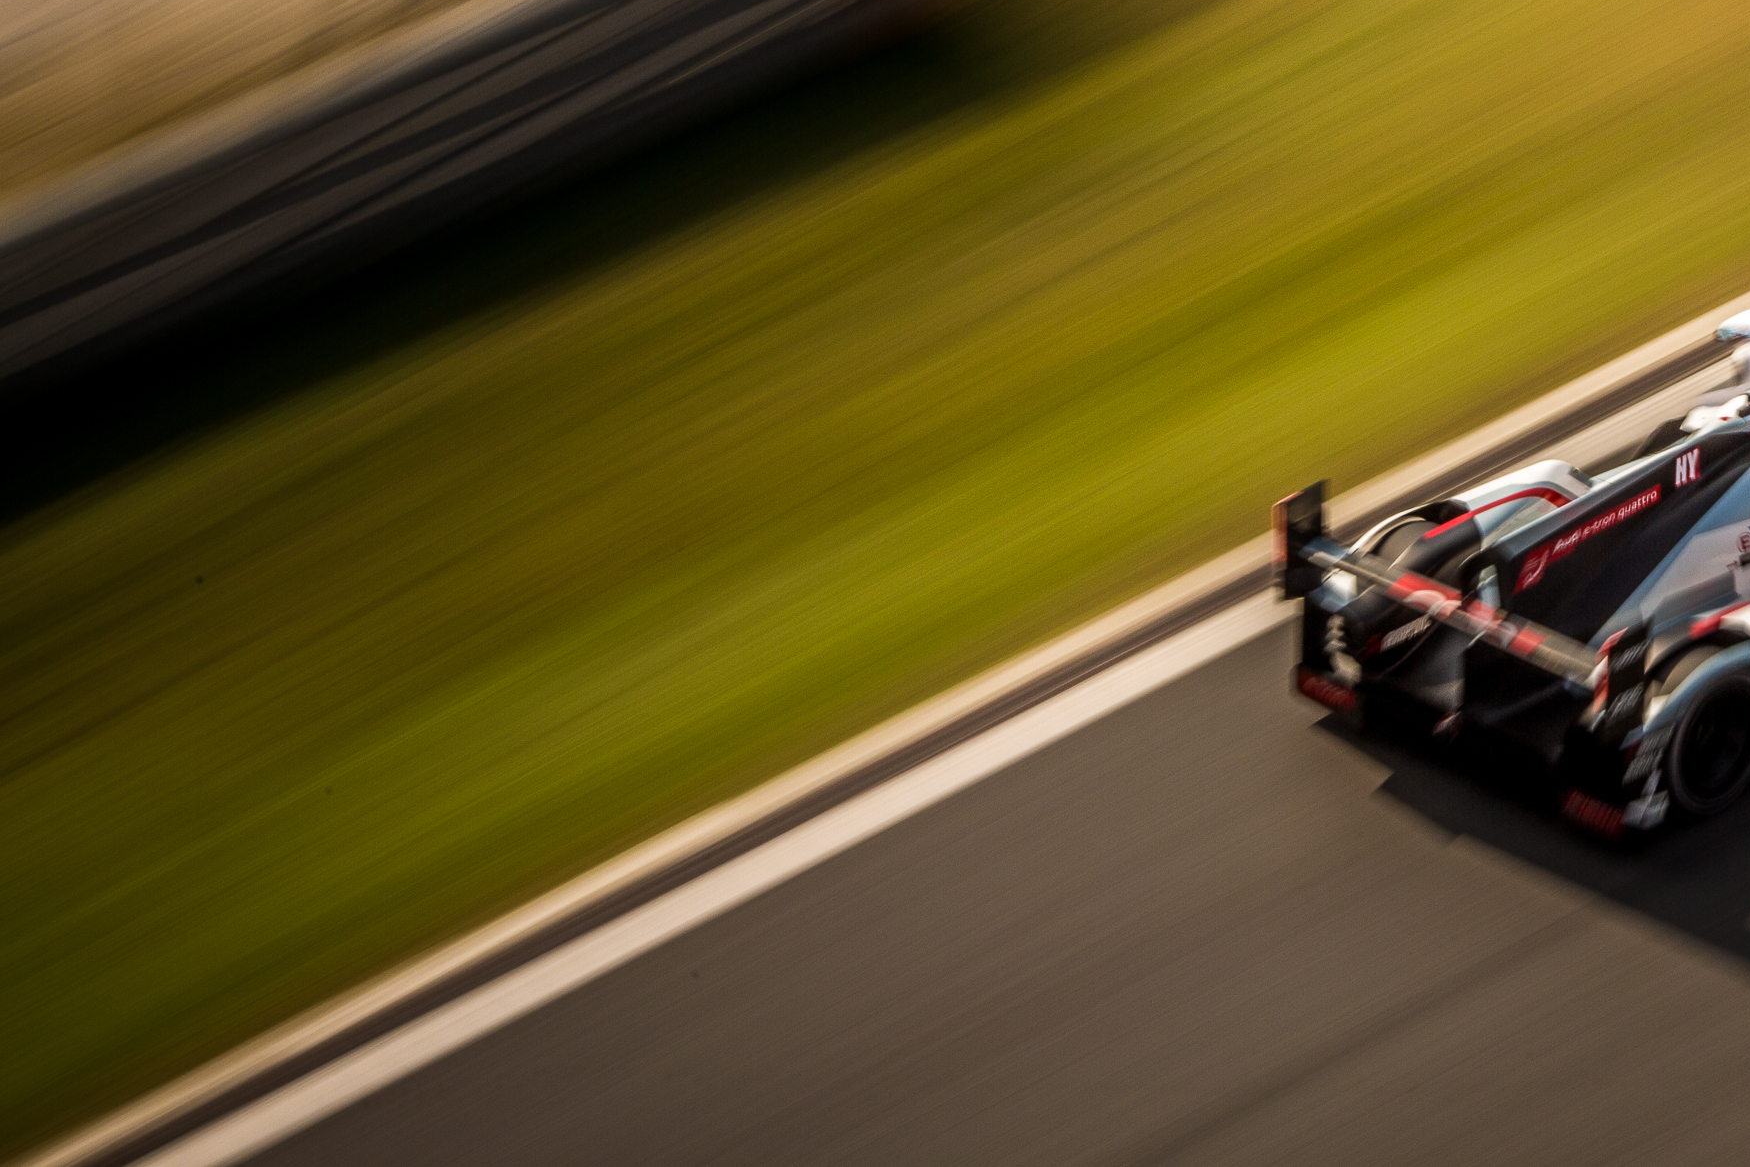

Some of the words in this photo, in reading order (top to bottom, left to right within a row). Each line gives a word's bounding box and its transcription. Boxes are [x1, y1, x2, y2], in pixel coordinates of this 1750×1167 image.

[1675, 448, 1699, 487] HY
[1552, 529, 1582, 555] Audi
[1583, 512, 1616, 538] e-tron
[1618, 489, 1658, 519] quattro
